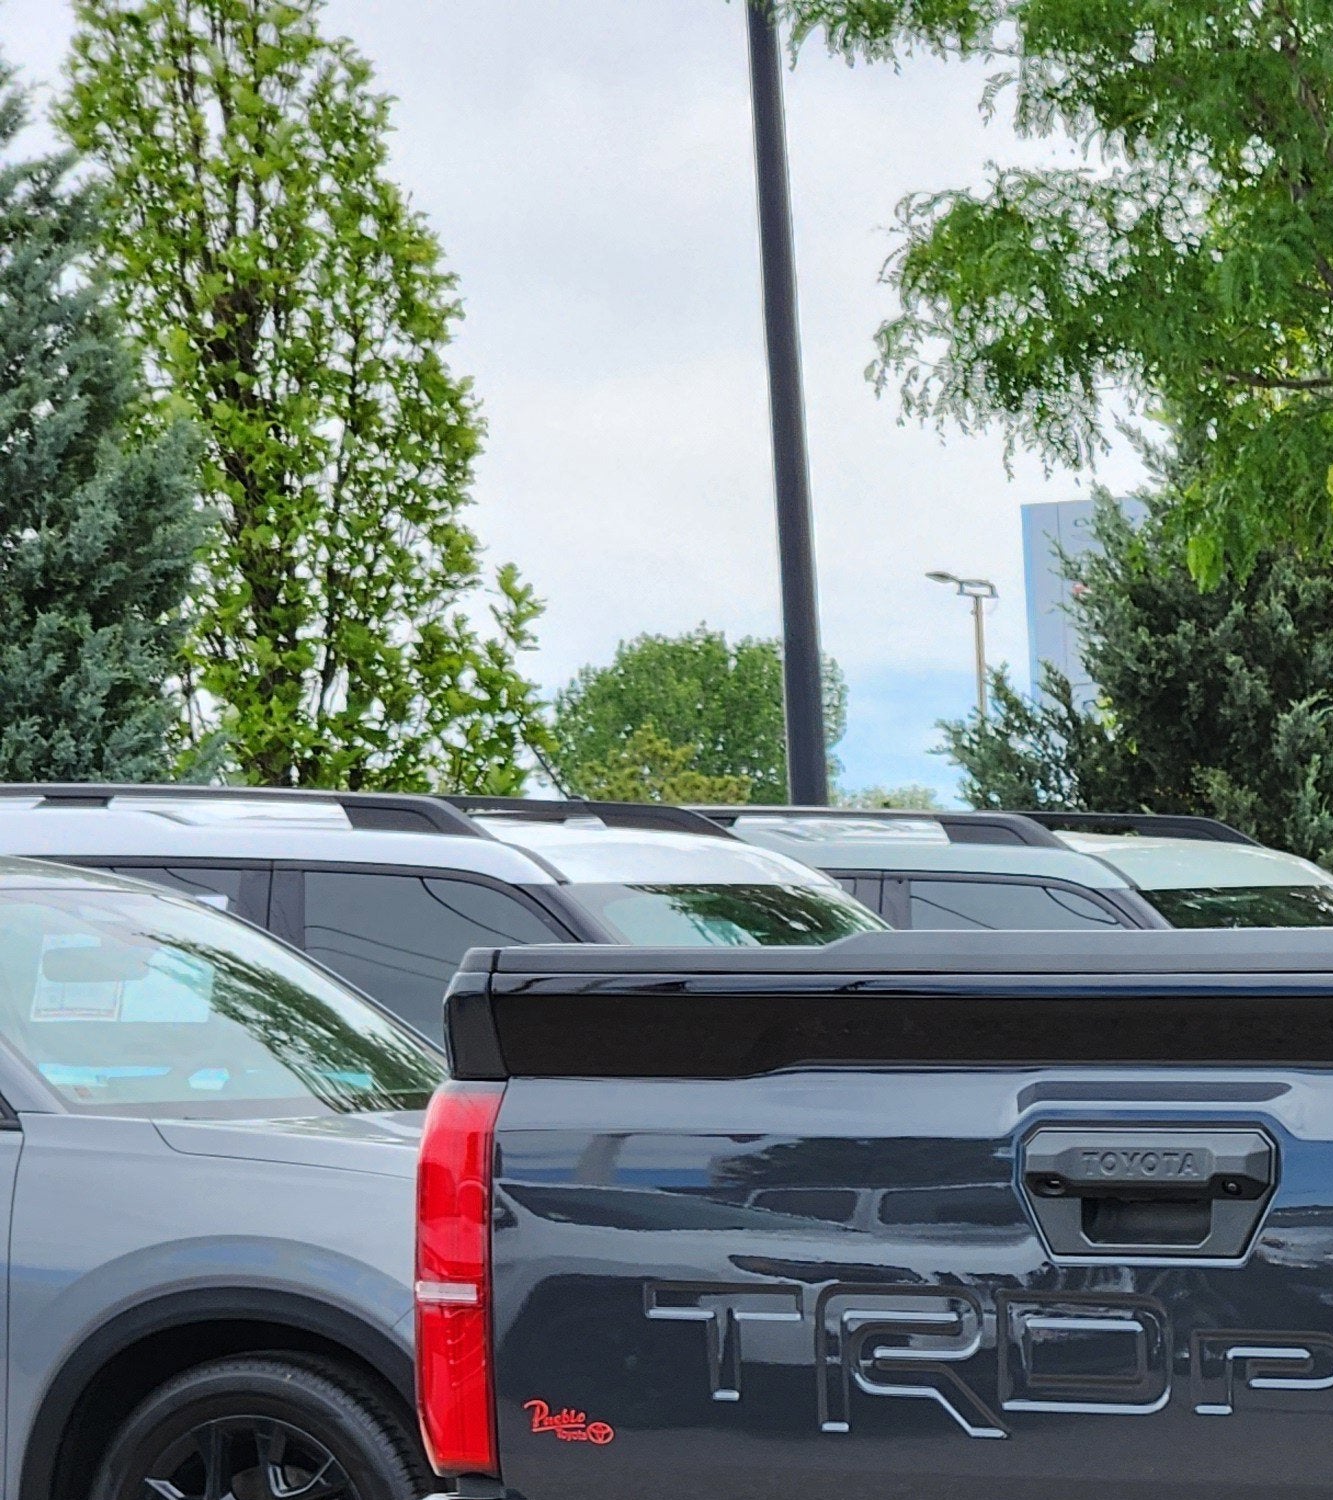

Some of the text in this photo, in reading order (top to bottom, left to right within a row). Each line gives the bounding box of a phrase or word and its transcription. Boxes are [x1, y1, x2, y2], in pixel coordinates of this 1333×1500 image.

[1081, 1151, 1199, 1177] TOYOTA
[642, 1280, 1174, 1440] TRD
[523, 1399, 586, 1429] Pueblo
